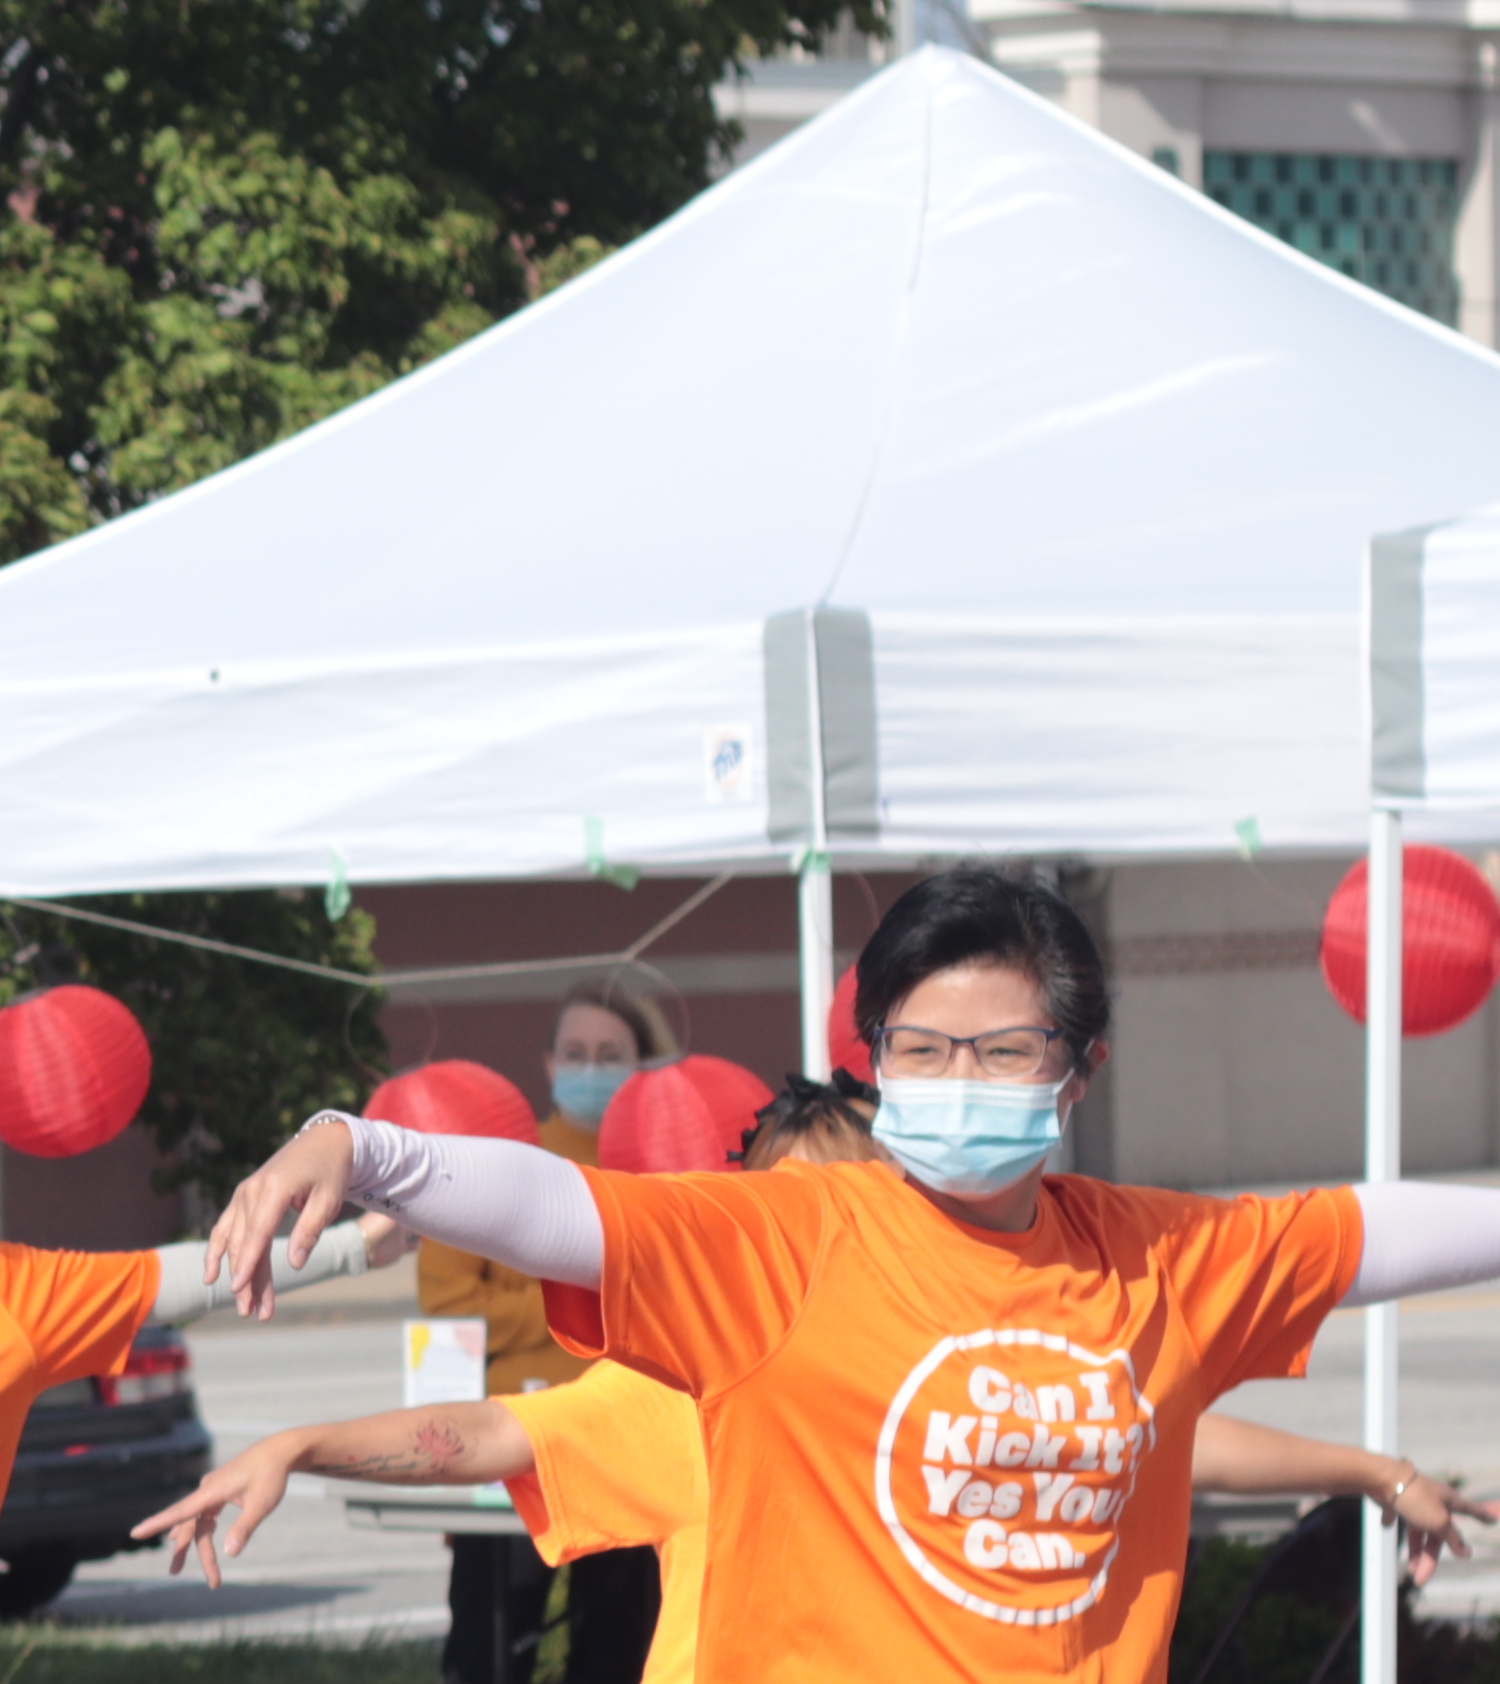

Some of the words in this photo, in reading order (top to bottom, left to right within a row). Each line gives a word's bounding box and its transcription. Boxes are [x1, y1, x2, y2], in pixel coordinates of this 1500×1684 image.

[968, 1365, 1076, 1423] Can
[1078, 1370, 1115, 1421] I
[923, 1410, 1067, 1469] Kick
[1068, 1423, 1144, 1474] It?
[921, 1464, 1023, 1518] Yes
[1032, 1471, 1122, 1524] You
[963, 1518, 1087, 1570] Can.
